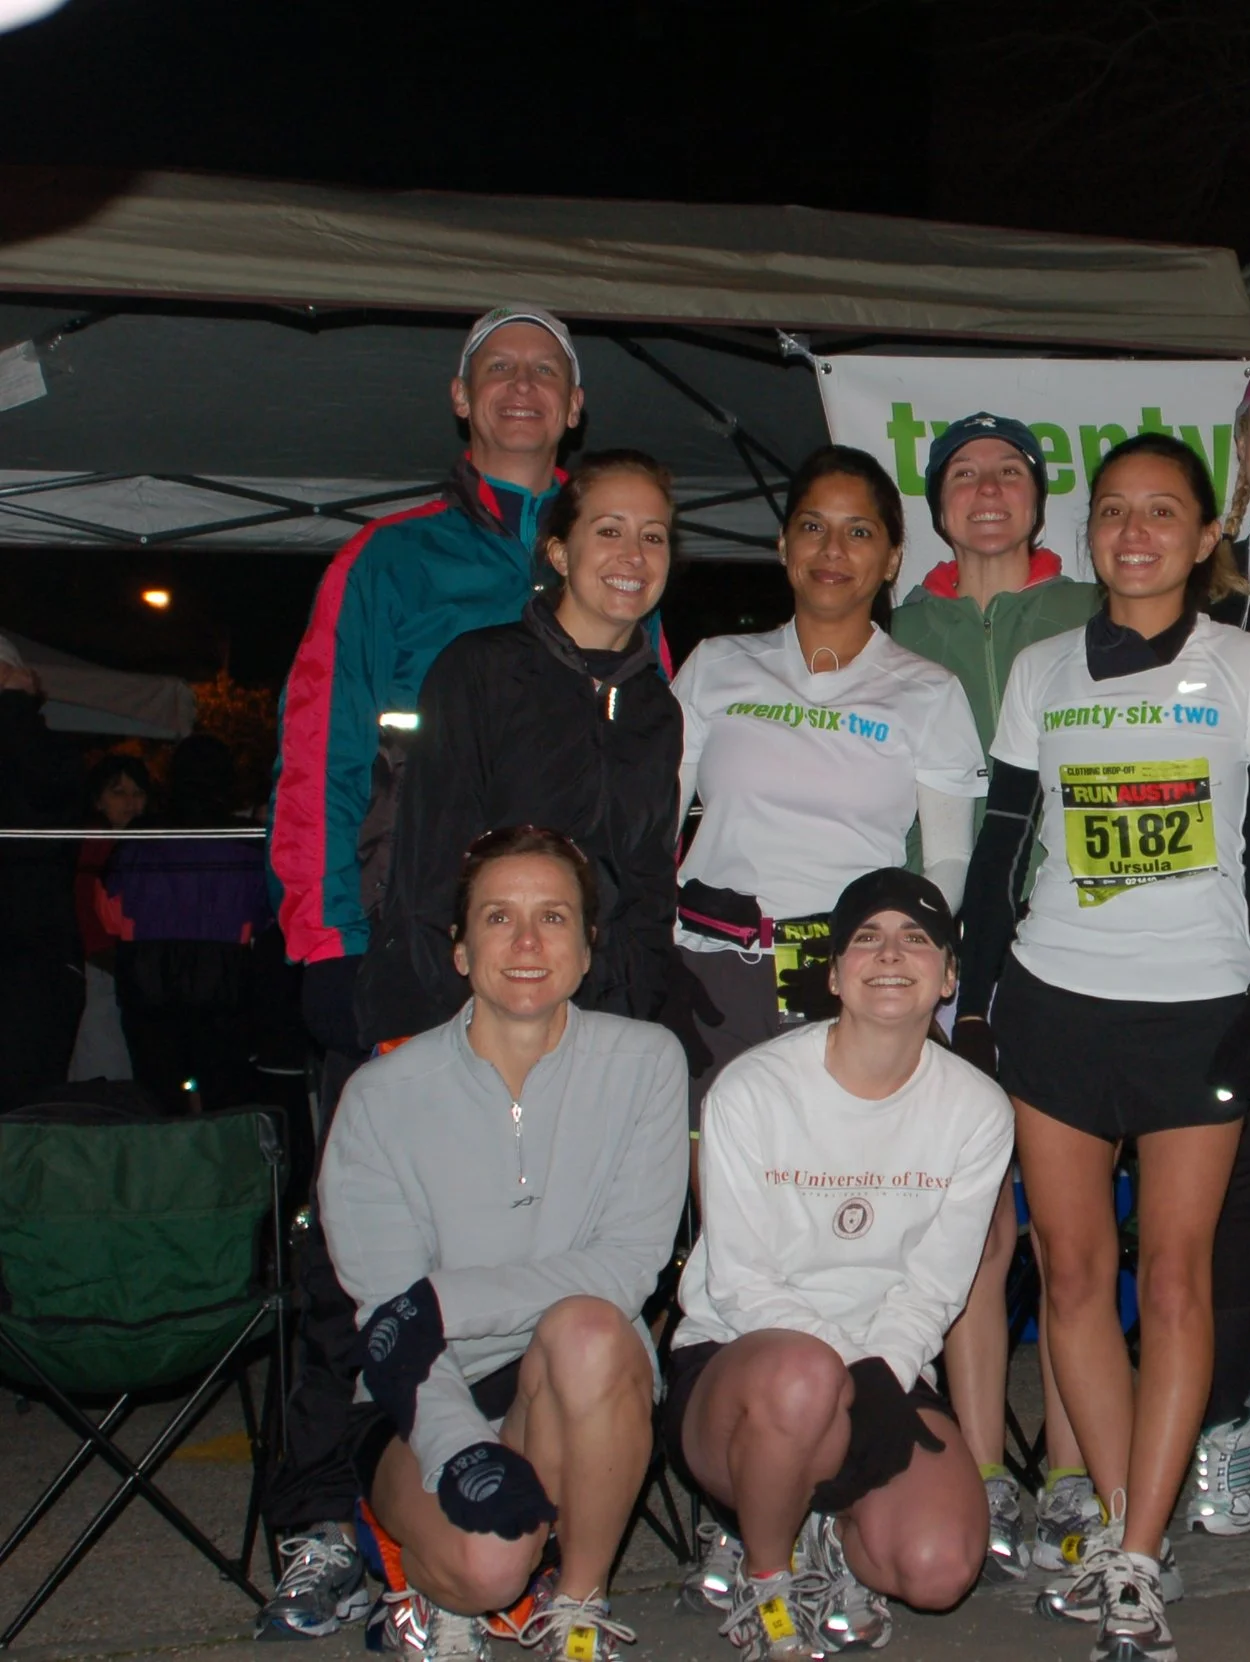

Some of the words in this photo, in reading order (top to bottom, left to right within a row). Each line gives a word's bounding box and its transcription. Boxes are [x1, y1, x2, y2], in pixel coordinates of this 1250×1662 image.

[1067, 766, 1101, 776] CLOTHING
[1103, 765, 1136, 776] DROP-OFF
[1084, 810, 1193, 860] 5182
[1109, 859, 1172, 874] Ursula
[794, 1169, 885, 1188] University
[892, 1171, 912, 1187] of
